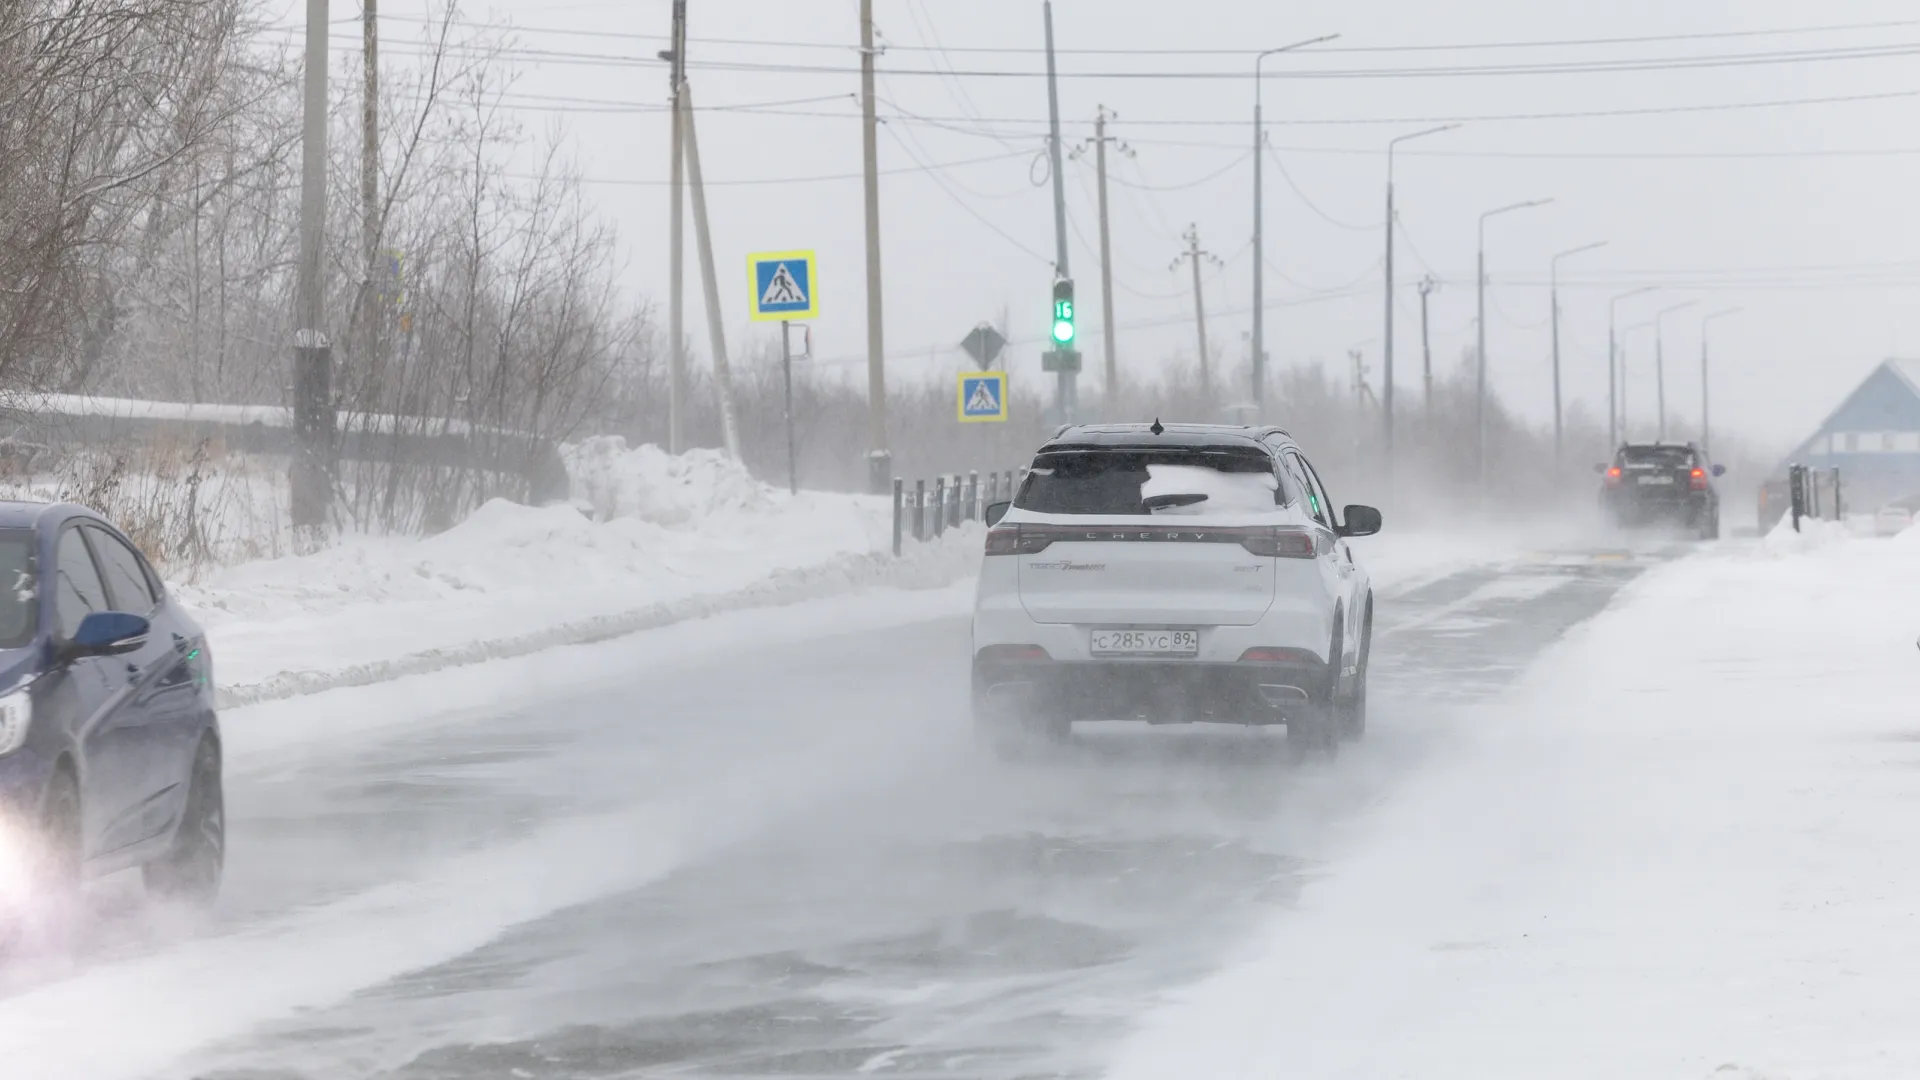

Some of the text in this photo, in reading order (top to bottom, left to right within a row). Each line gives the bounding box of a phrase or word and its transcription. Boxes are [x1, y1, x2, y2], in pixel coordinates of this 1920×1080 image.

[1055, 301, 1072, 319] 16
[1086, 532, 1204, 540] CHERY
[1173, 632, 1191, 646] 89
